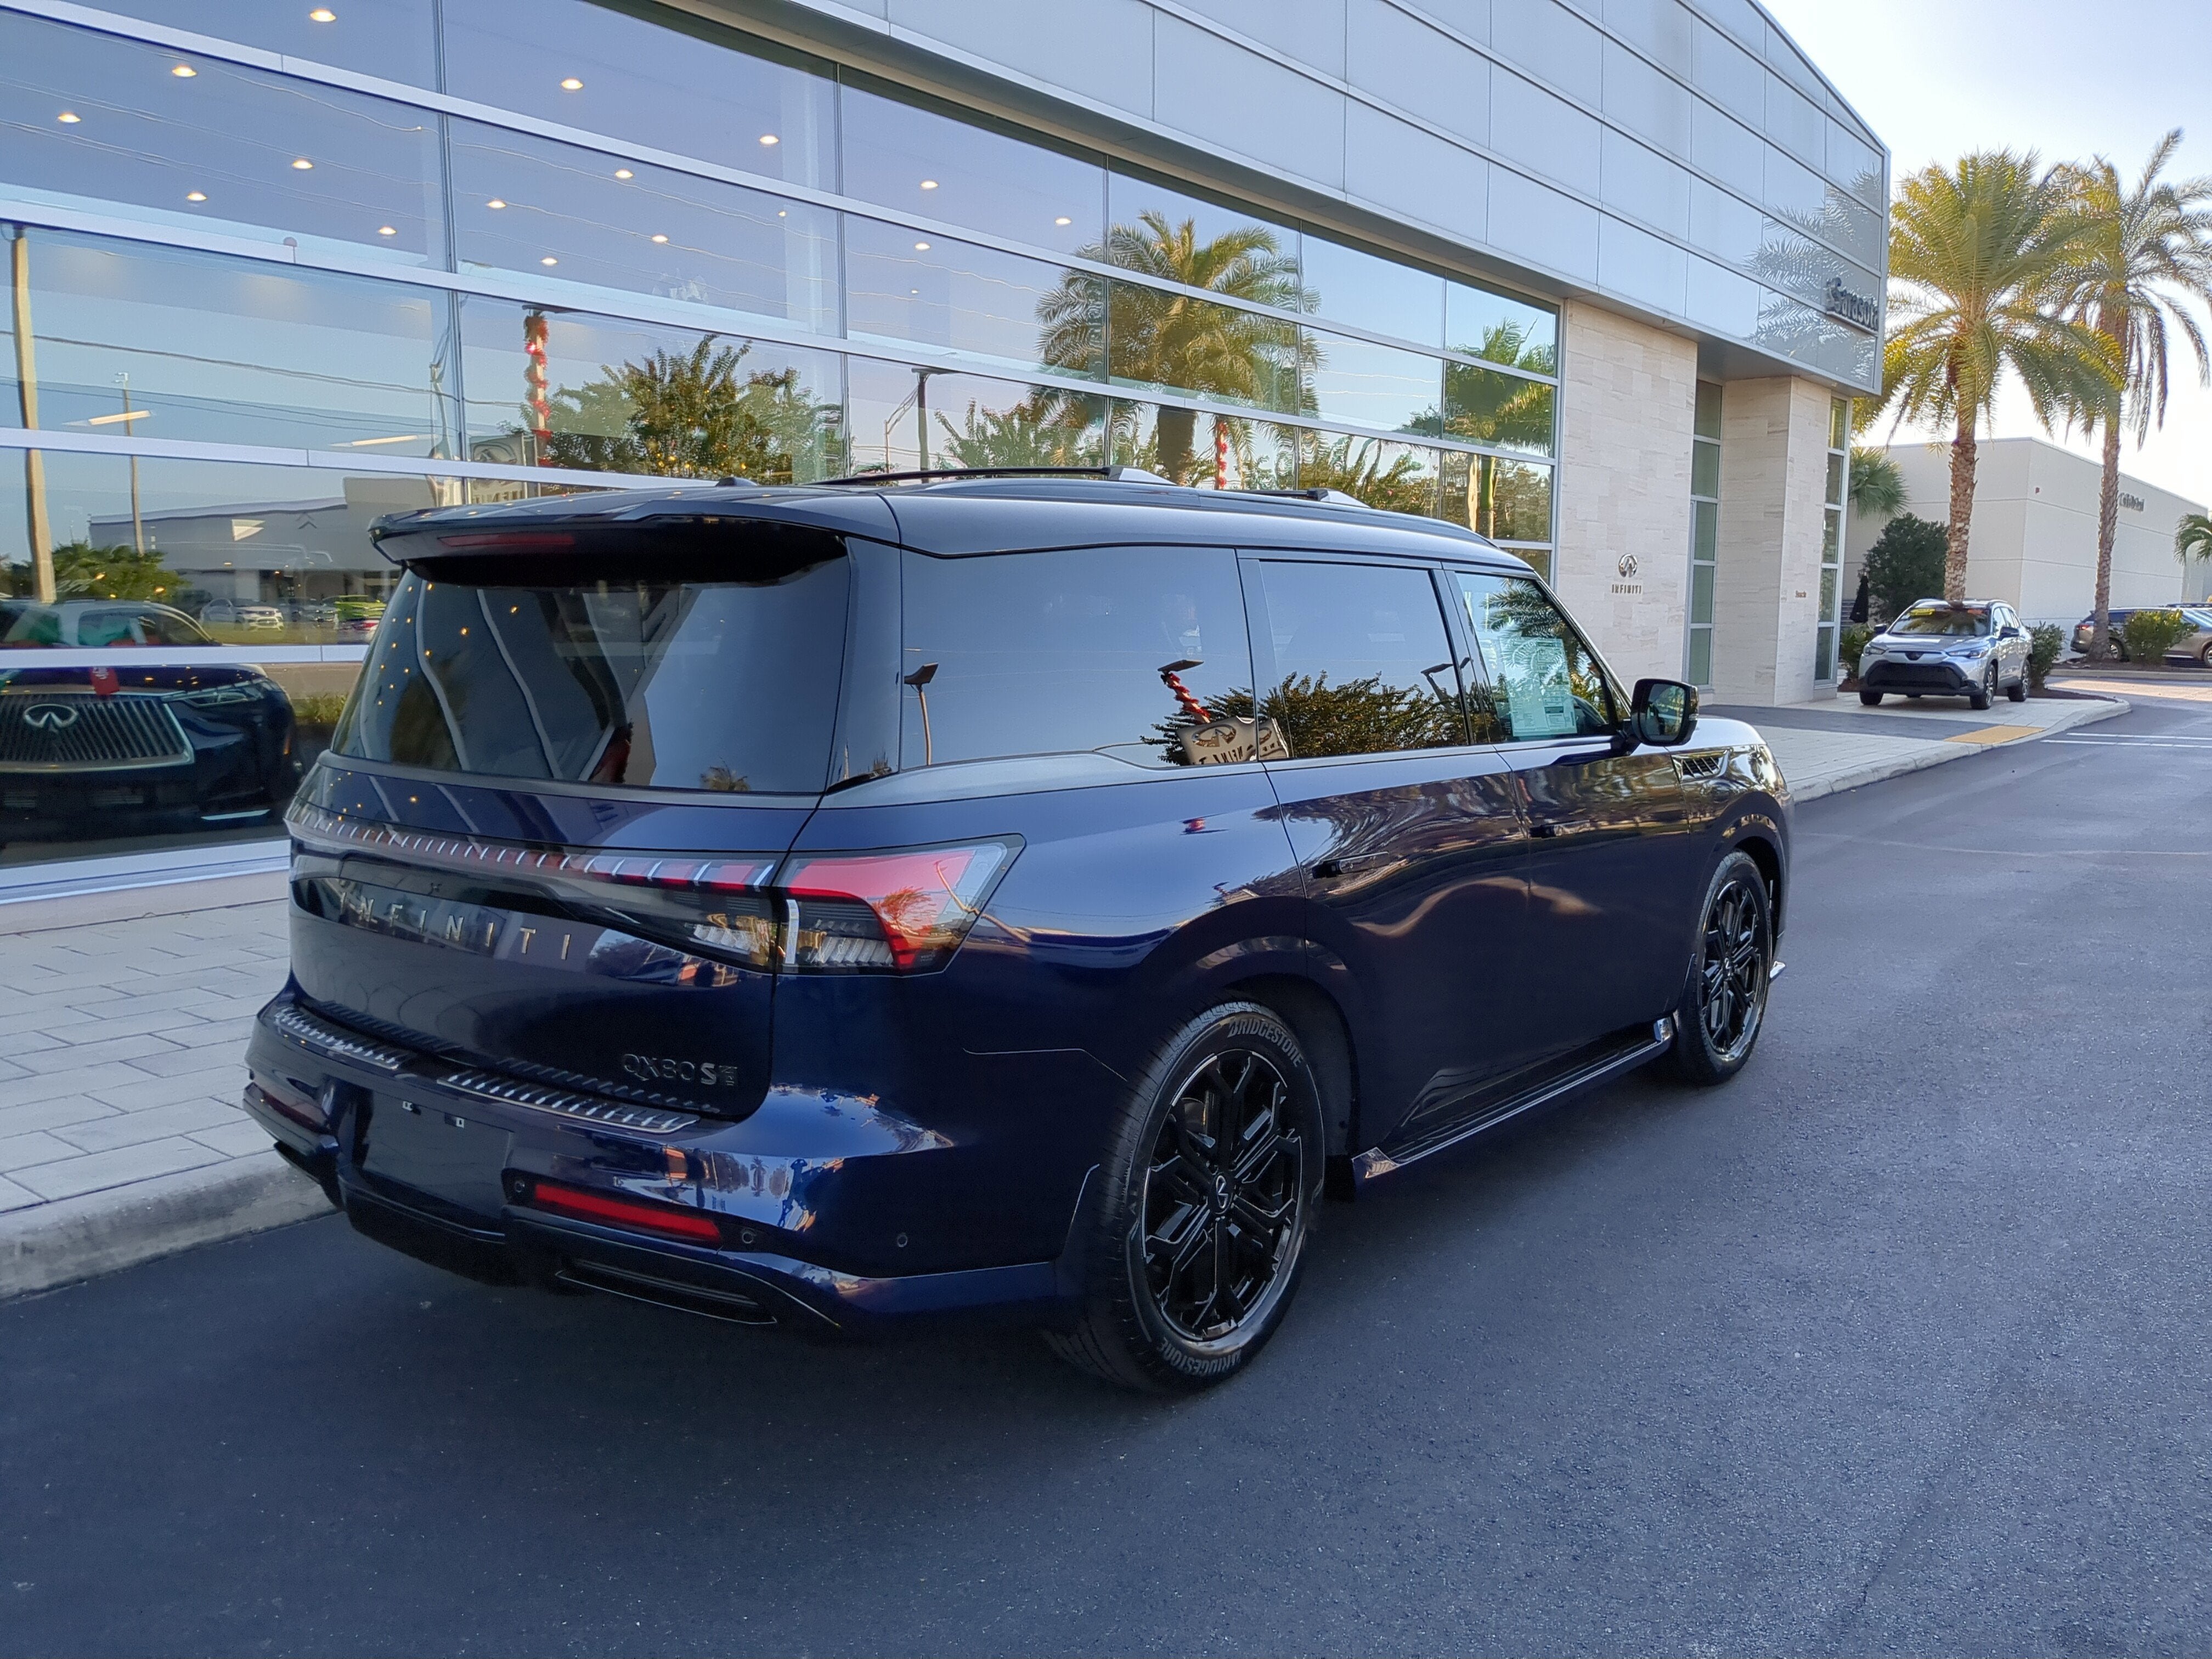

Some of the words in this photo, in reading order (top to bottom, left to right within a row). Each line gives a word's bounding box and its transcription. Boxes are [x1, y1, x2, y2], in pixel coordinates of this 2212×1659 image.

[1611, 584, 1642, 594] INFINITI
[340, 891, 572, 961] INFINITI
[1227, 1017, 1304, 1067] BRIDGESTONE
